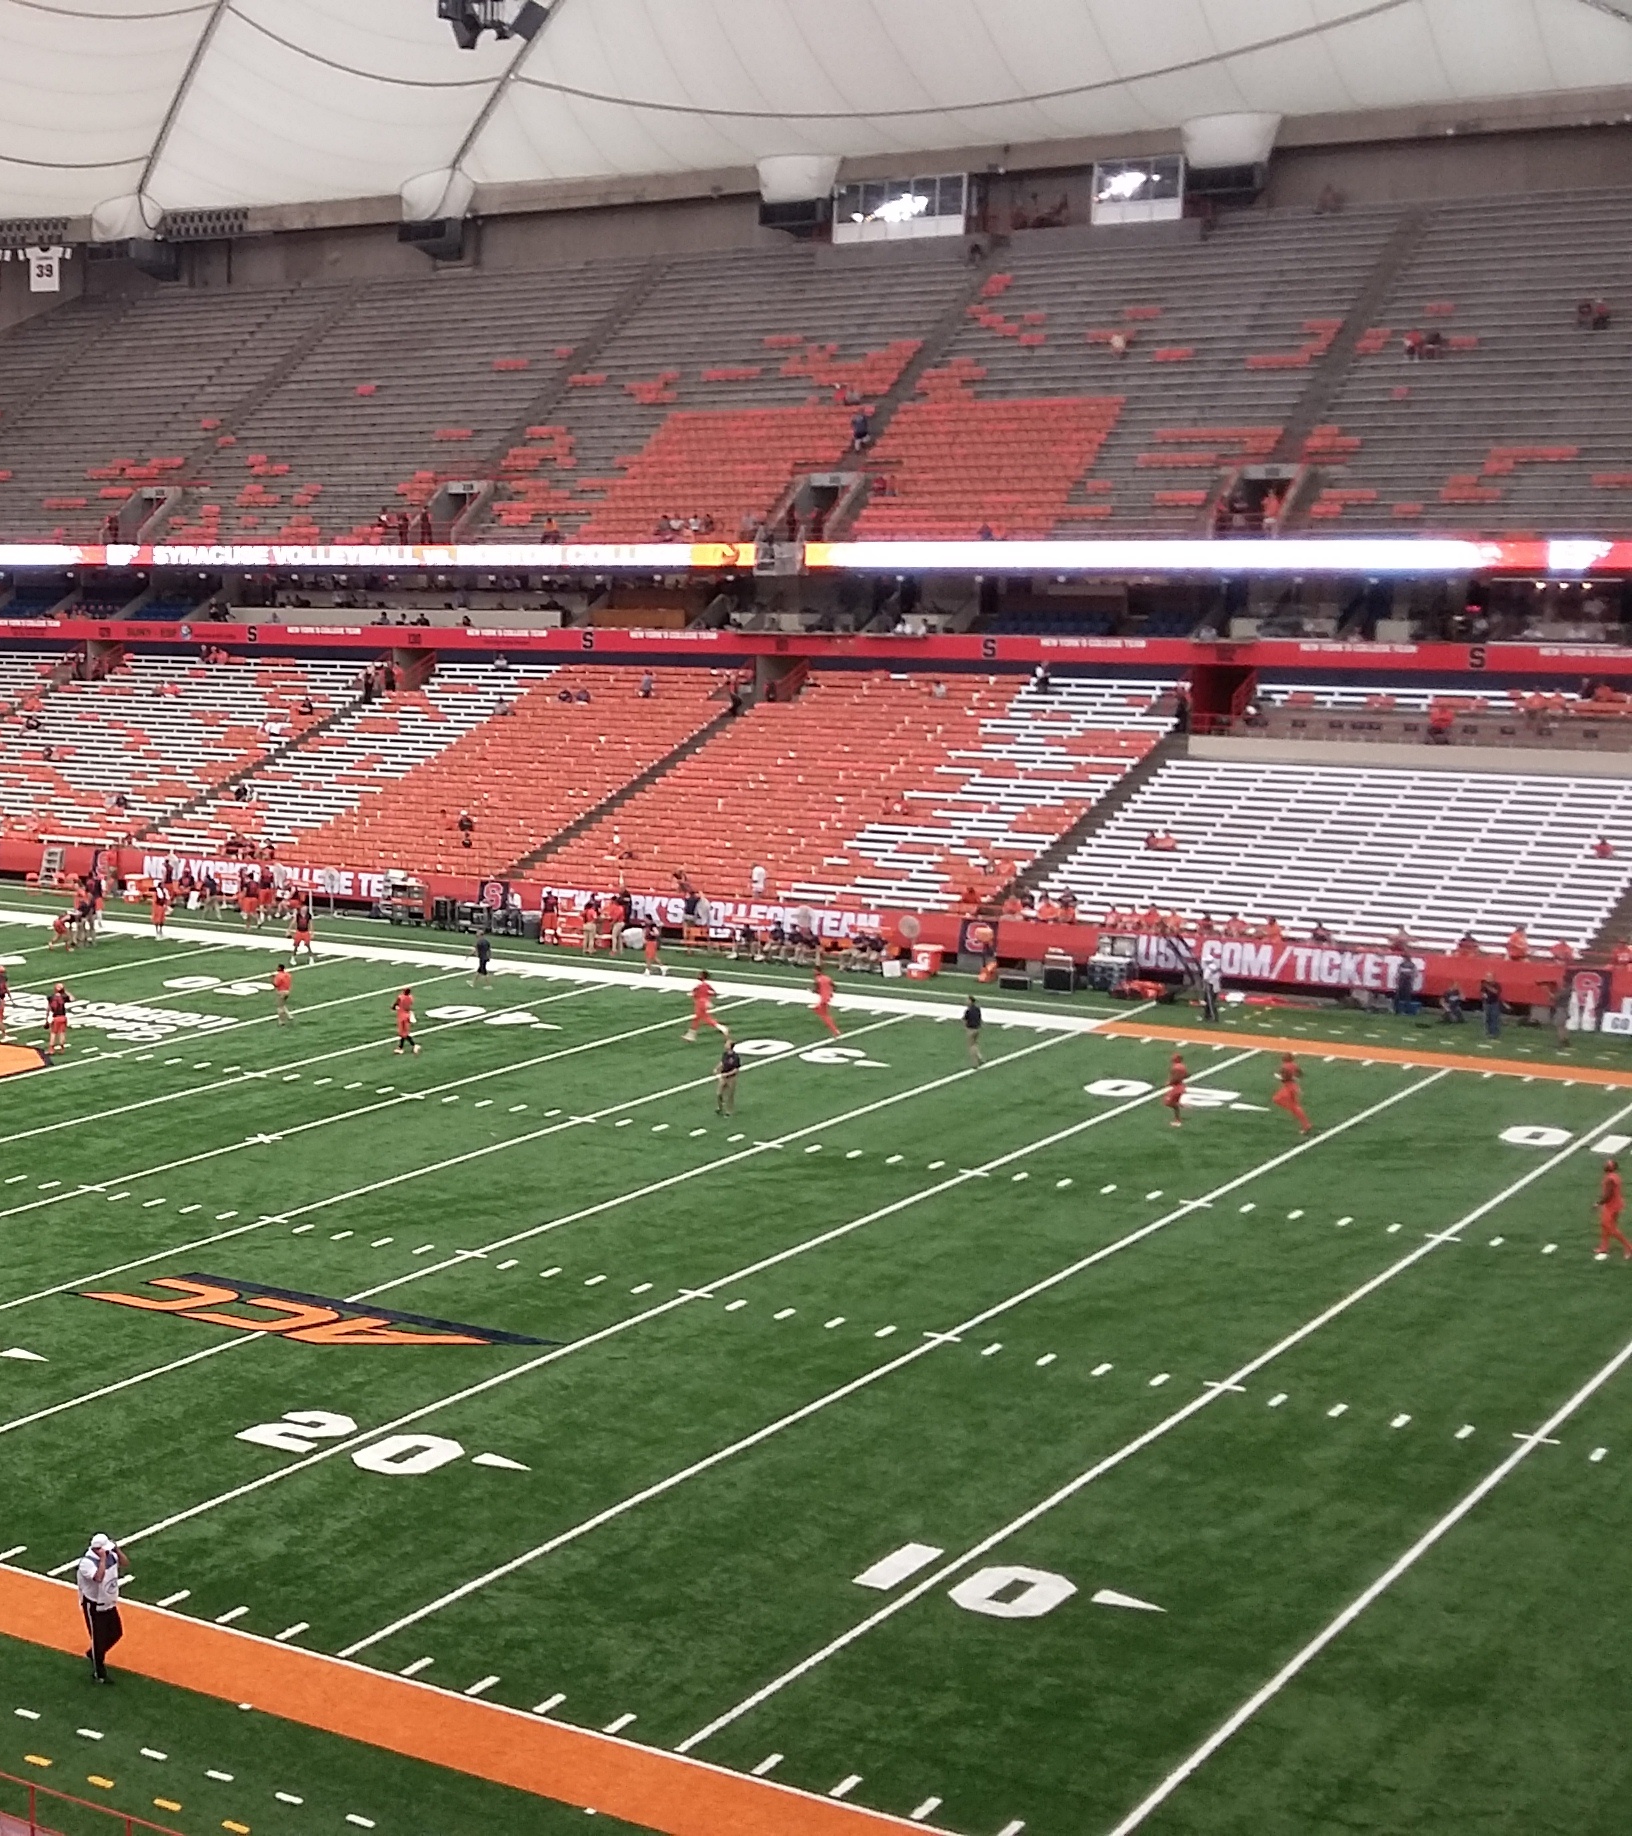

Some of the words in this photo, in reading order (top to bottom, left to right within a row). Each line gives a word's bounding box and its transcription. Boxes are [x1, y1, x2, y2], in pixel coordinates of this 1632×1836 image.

[36, 264, 53, 279] 39
[153, 546, 268, 565] SYRACUSE
[273, 546, 419, 565] VOLLEYBALL
[247, 626, 257, 641] S
[581, 631, 594, 650] S
[983, 638, 997, 659] S
[1469, 648, 1486, 669] S
[484, 883, 506, 910] S
[234, 1410, 465, 1475] 20
[852, 1543, 1078, 1619] 10
